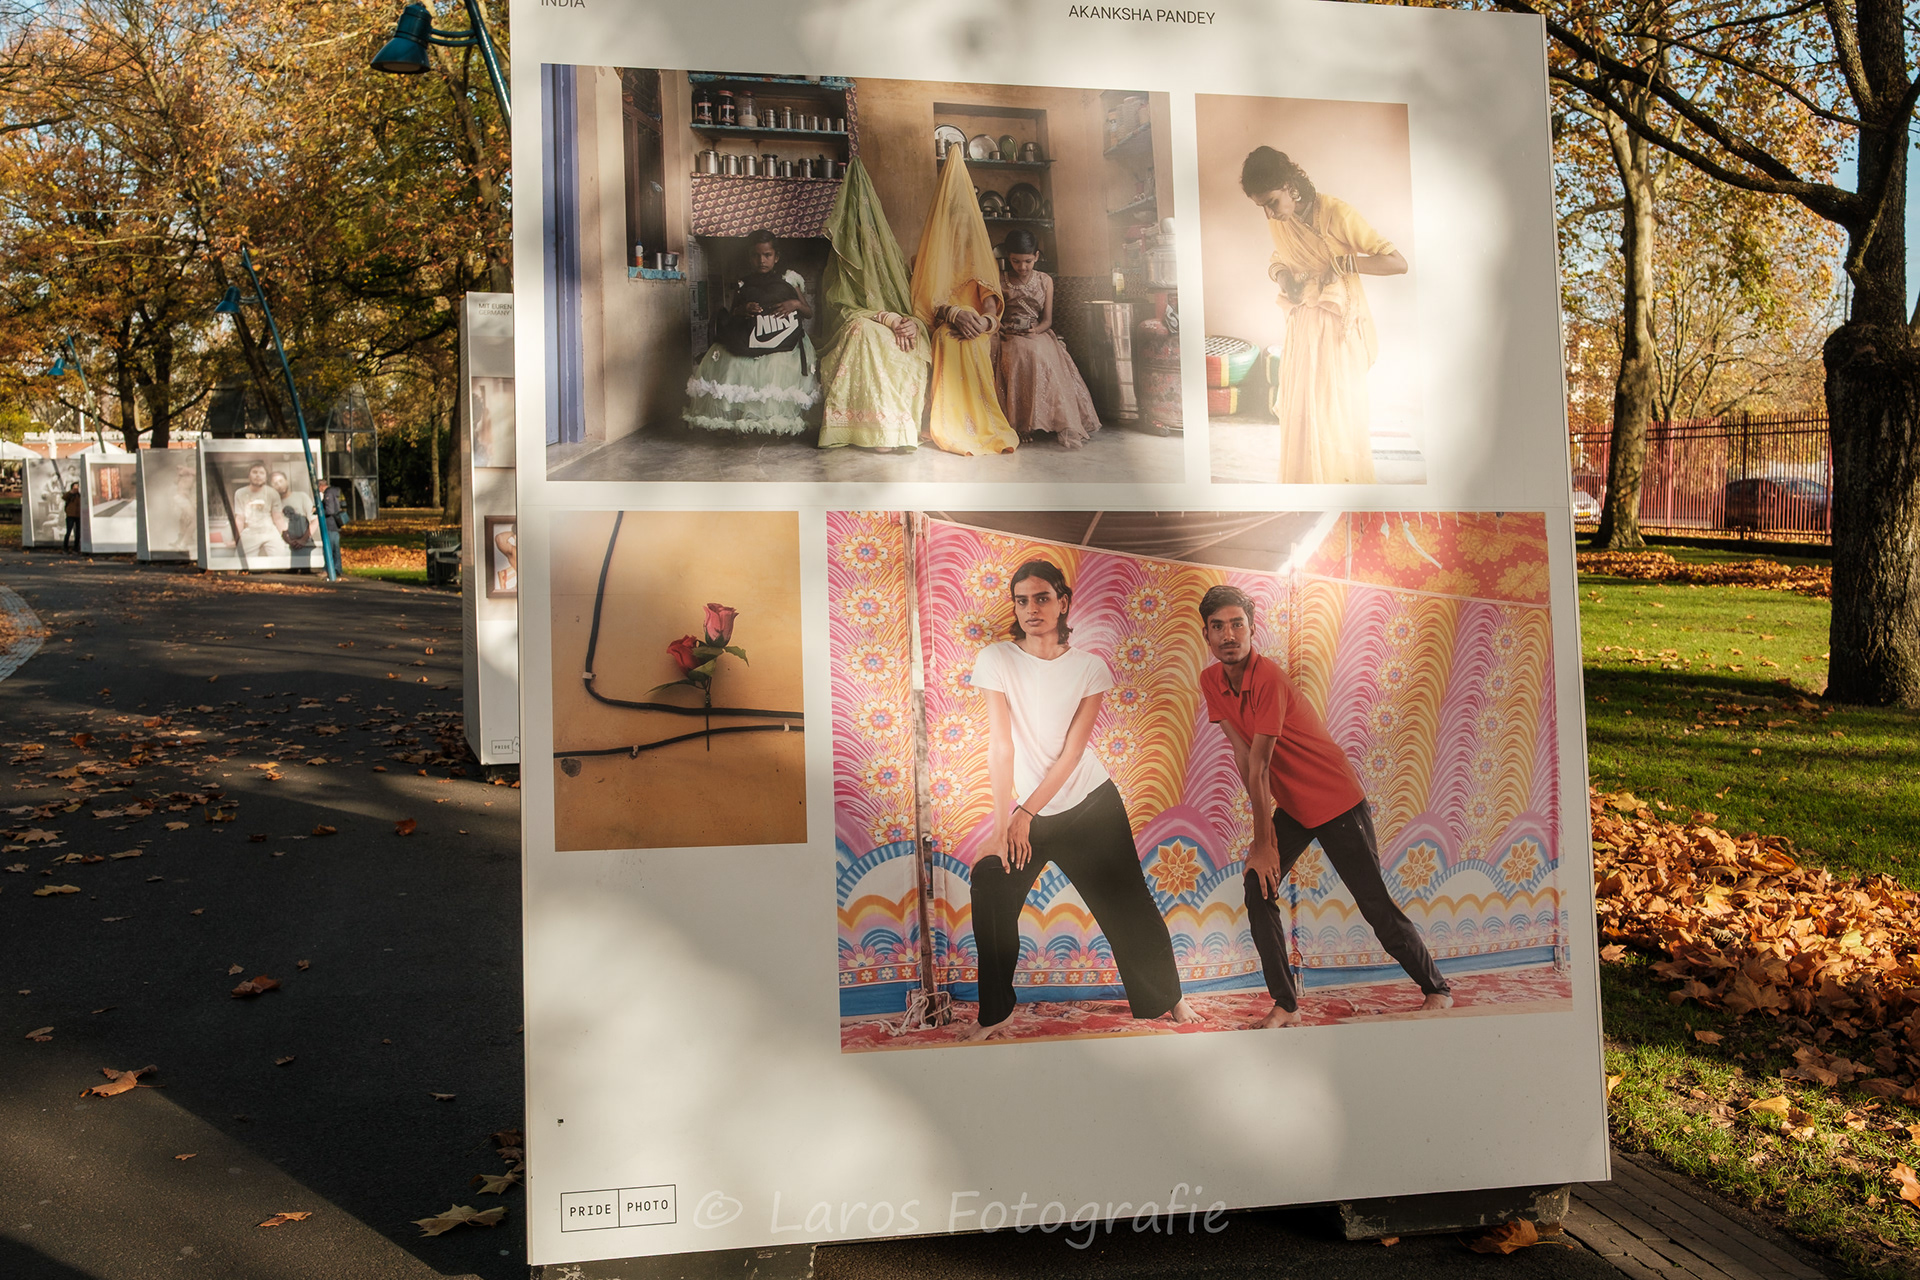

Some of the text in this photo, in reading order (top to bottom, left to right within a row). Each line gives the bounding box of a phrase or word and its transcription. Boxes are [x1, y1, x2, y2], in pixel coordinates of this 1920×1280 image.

[1069, 5, 1215, 24] AKANKSHA PANDEY
[756, 310, 799, 337] NIKE
[570, 1199, 668, 1217] PRIDE PHOTO
